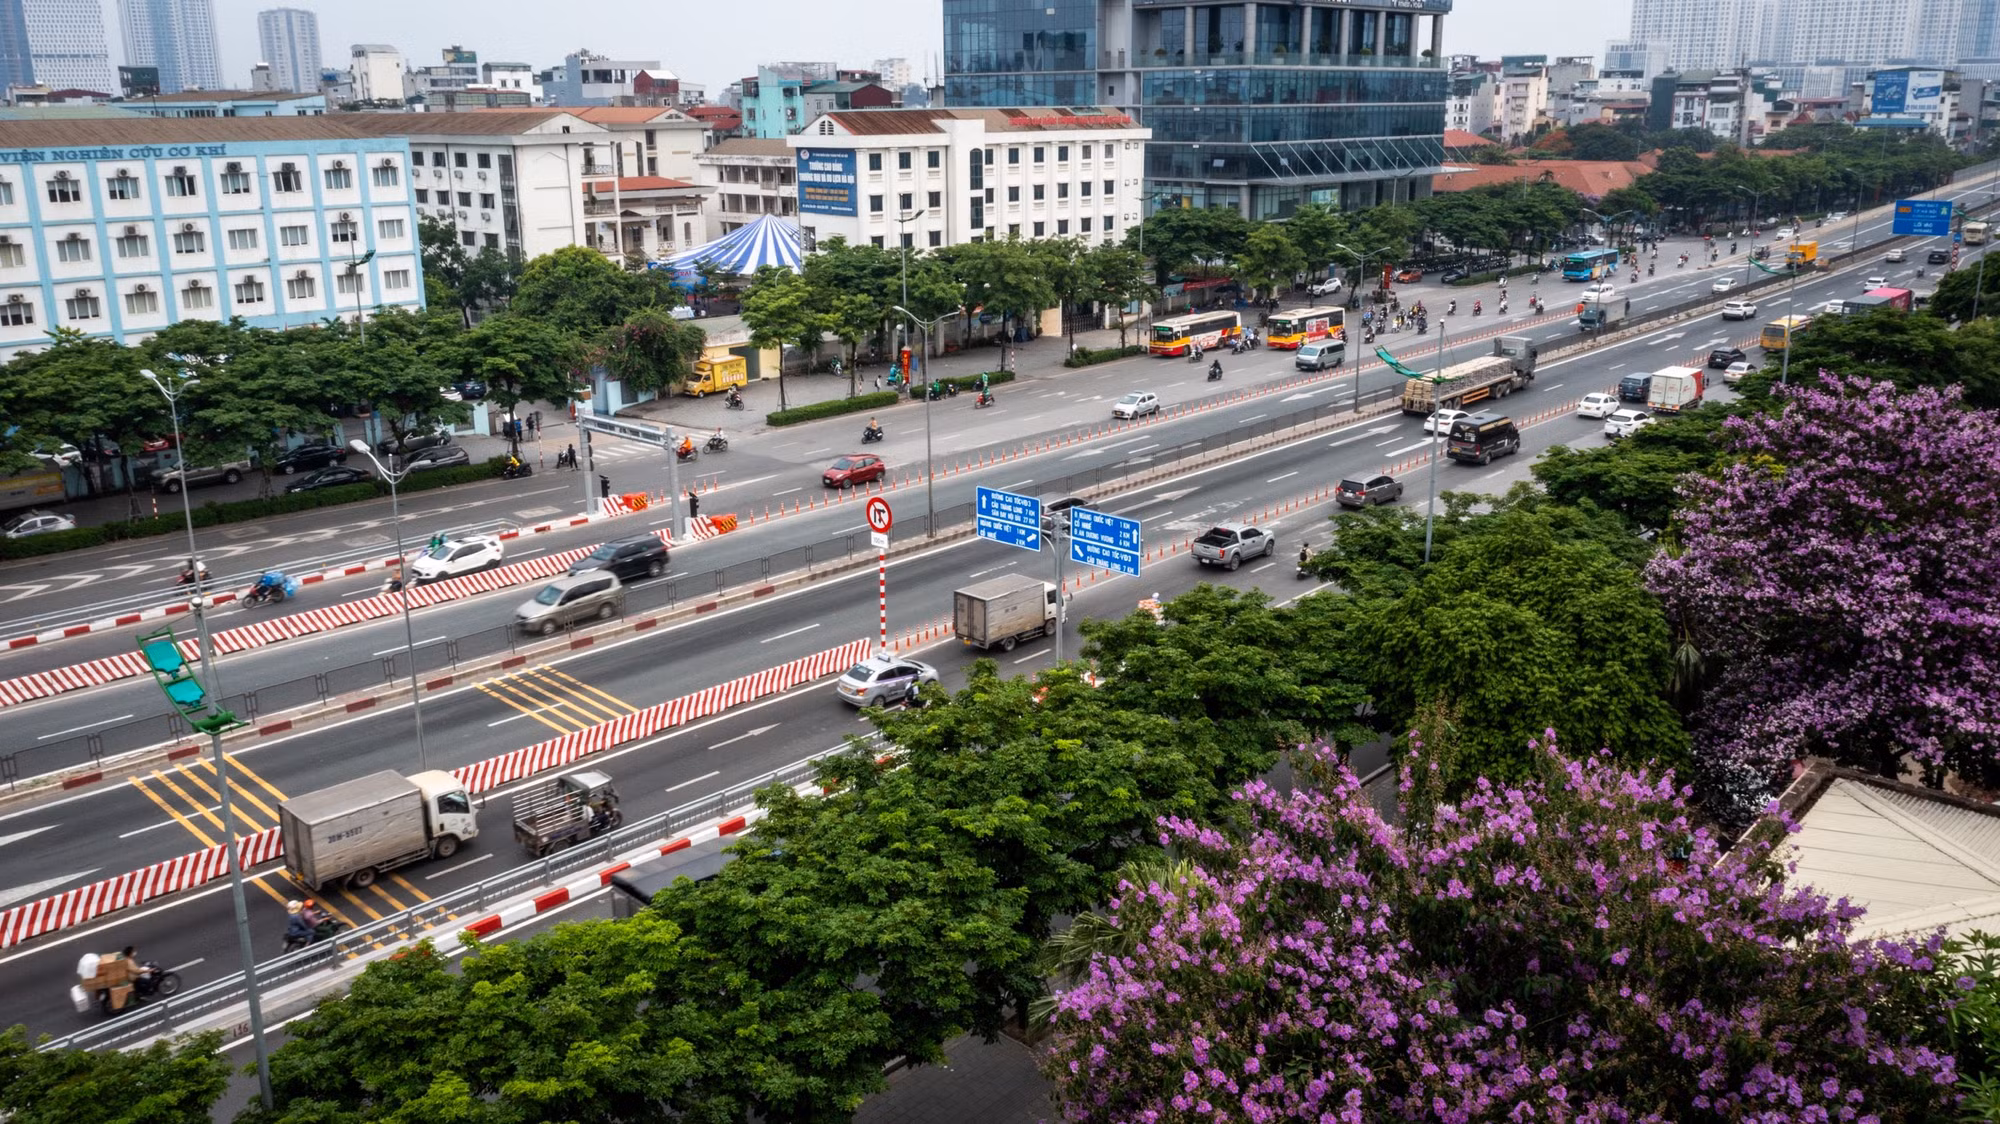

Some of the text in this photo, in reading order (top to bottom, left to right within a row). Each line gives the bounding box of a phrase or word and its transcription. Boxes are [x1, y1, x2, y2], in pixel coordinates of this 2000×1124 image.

[52, 147, 124, 161] NGHIÊN
[168, 145, 191, 157] CƠ
[195, 144, 227, 156] KHÍ
[1093, 514, 1104, 524] QUỐC
[1105, 518, 1113, 526] VIỆT
[1102, 549, 1110, 557] CAO
[1111, 562, 1121, 570] LONG
